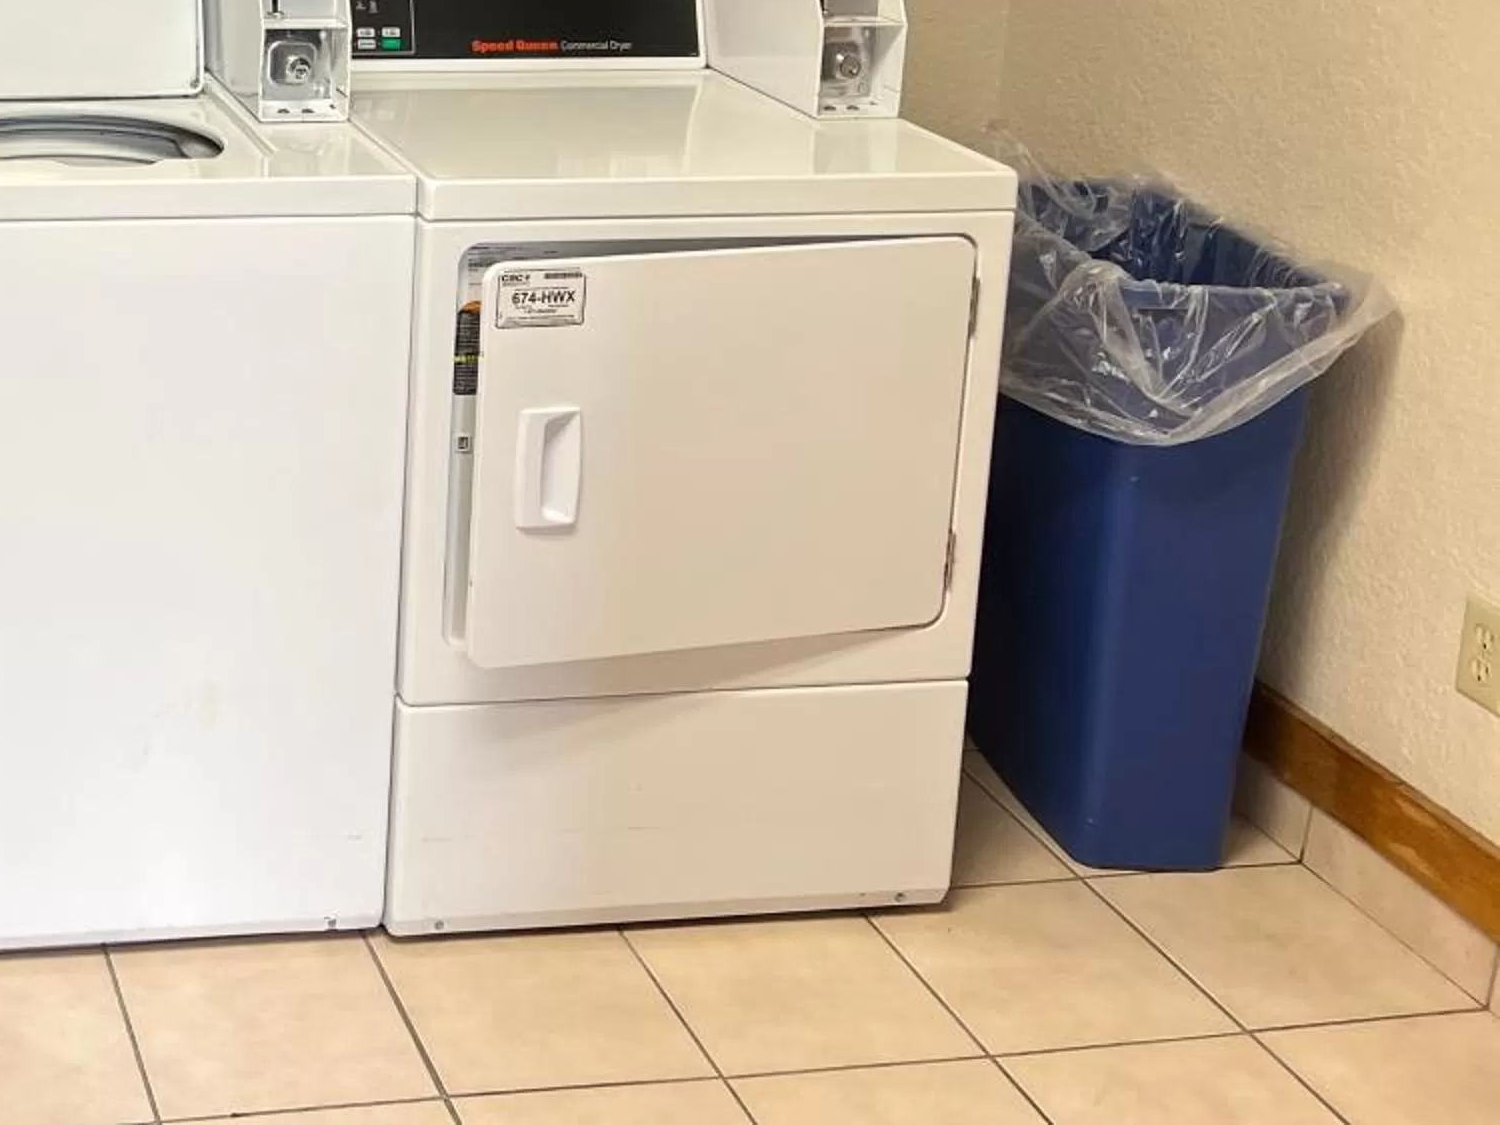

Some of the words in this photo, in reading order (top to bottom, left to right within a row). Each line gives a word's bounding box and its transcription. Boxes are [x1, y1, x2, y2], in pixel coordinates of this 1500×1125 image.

[471, 39, 514, 53] Speed
[516, 39, 558, 51] Queen
[560, 40, 608, 51] Commercial
[610, 40, 632, 52] Dryer
[512, 290, 576, 304] 674-HWX
